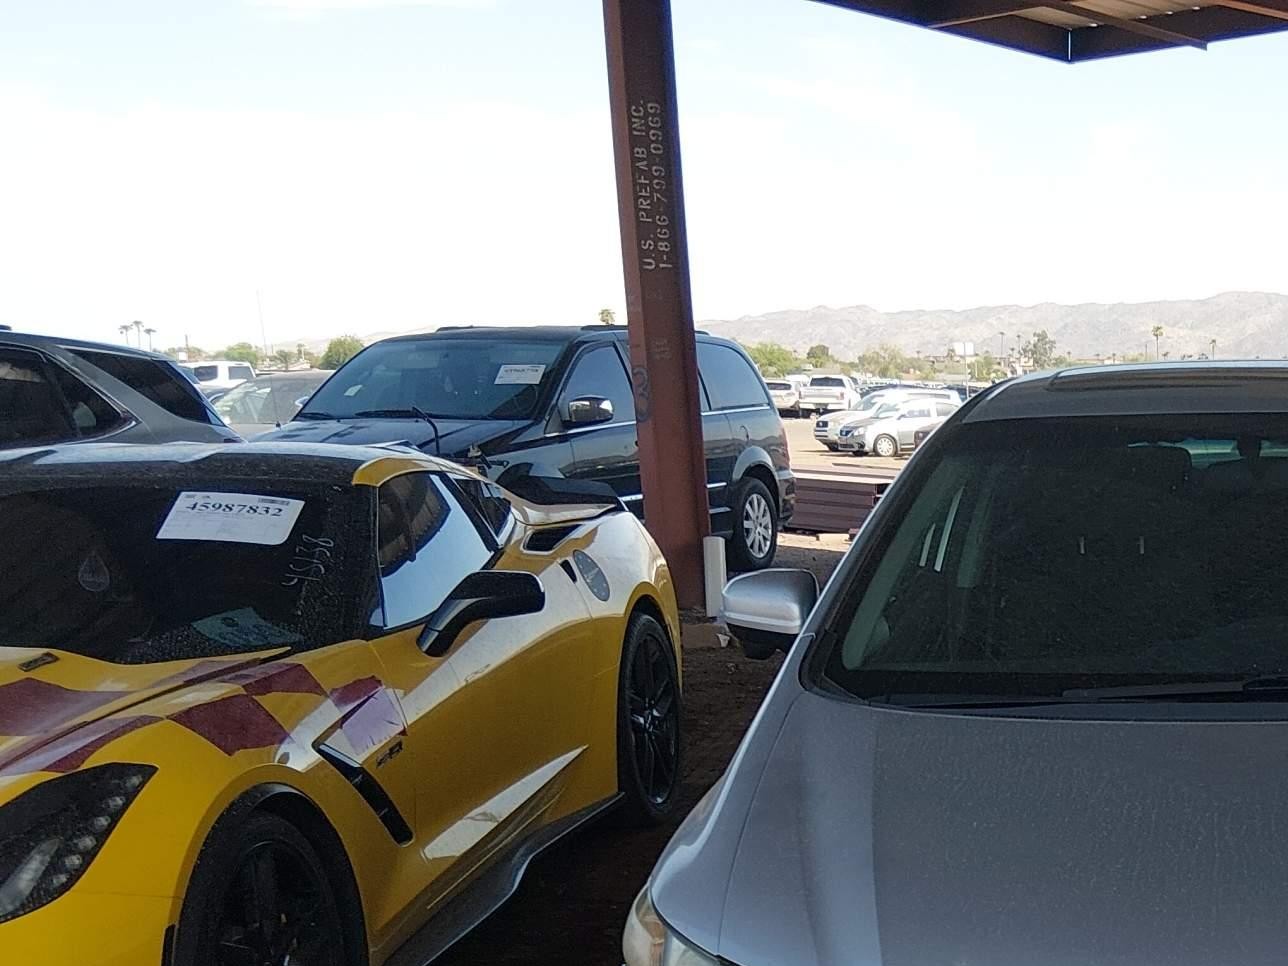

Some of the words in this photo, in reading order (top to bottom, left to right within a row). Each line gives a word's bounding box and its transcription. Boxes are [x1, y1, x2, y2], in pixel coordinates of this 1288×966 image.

[631, 100, 645, 136] INC.
[634, 147, 652, 222] PREFAB
[640, 234, 656, 270] U.S.
[185, 501, 283, 517] 45987832
